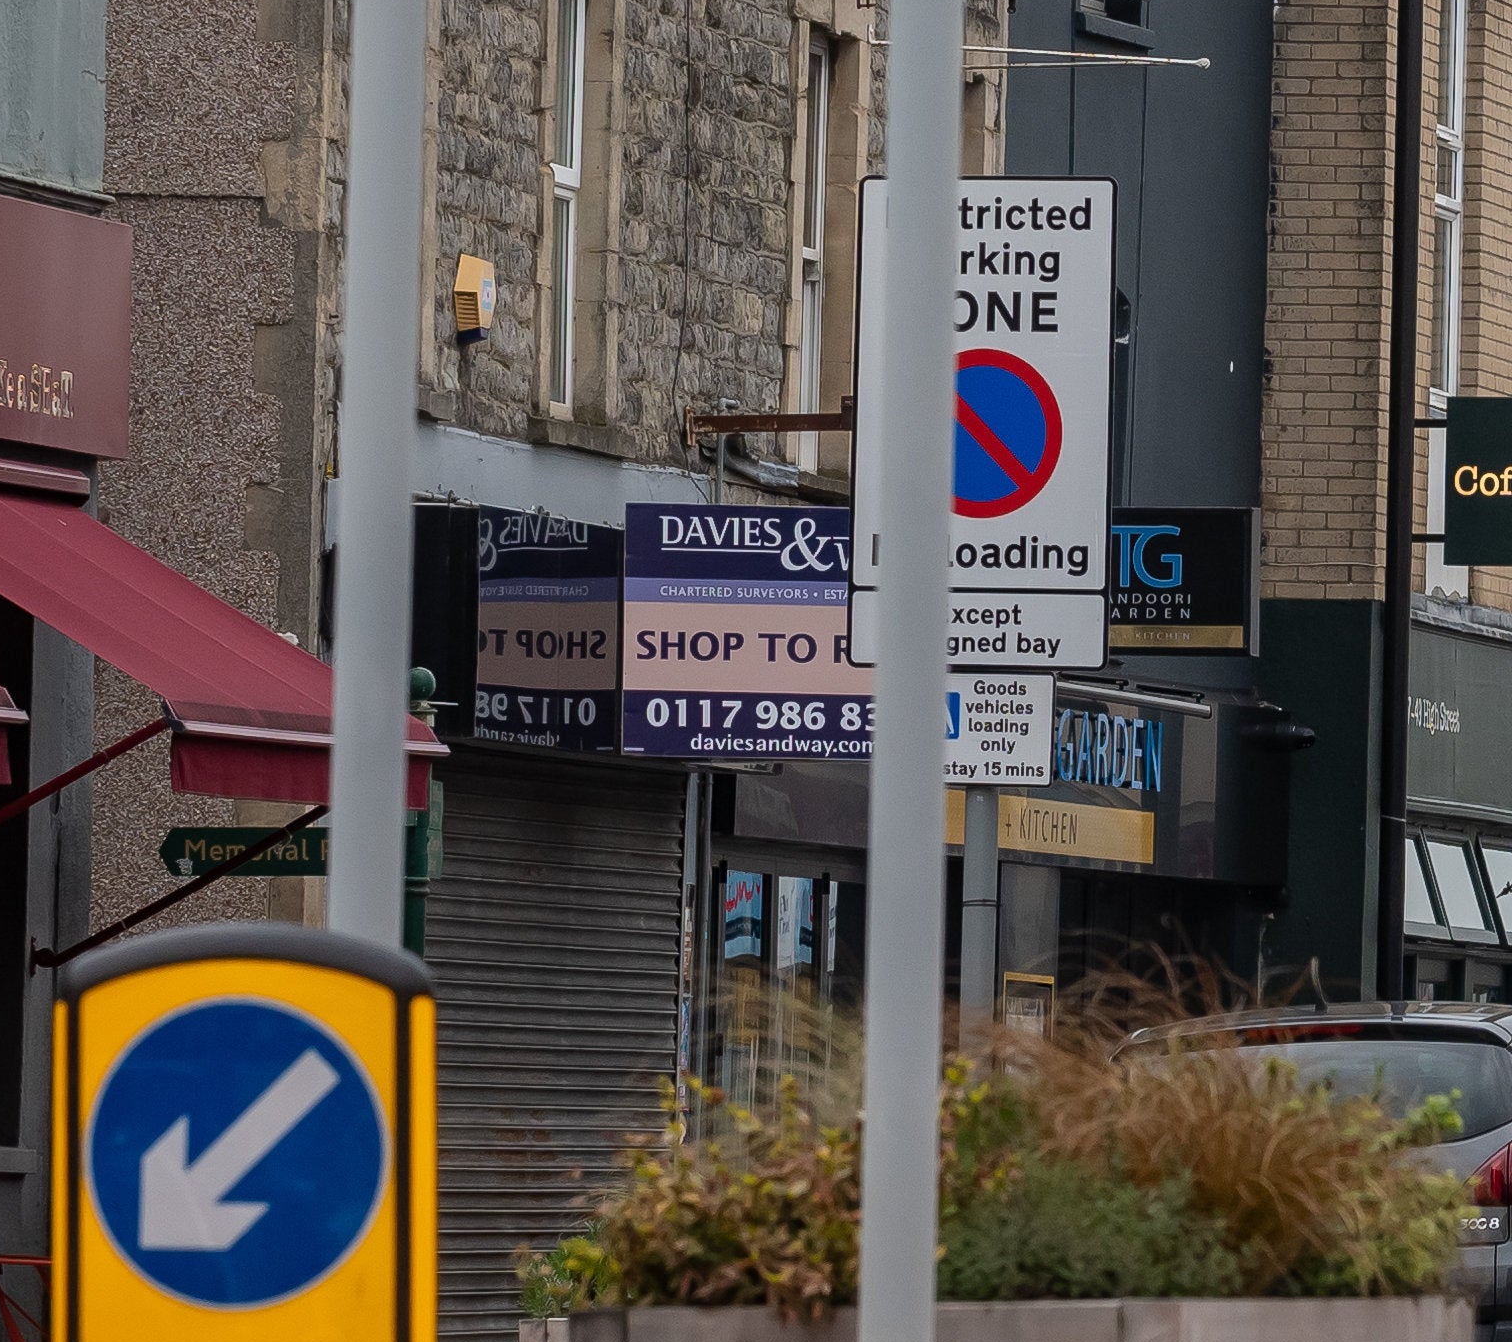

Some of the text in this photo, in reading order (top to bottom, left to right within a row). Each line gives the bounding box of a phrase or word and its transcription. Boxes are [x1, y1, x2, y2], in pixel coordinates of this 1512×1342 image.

[956, 196, 1092, 231] tricted
[958, 241, 1061, 283] rking
[953, 290, 1059, 333] ONE
[659, 515, 782, 548] DAVIES
[781, 517, 834, 572] &
[947, 536, 1089, 577] oading
[659, 585, 849, 601] CHARTERED SURVEYORS ESTA
[1110, 593, 1191, 605] NDOORI
[949, 604, 1022, 628] xcept
[1111, 608, 1191, 619] ARDEN
[636, 630, 745, 662] SHOP
[758, 633, 817, 664] TO
[947, 632, 1061, 659] gned bay
[973, 679, 1027, 696] Goods
[646, 698, 742, 729] 0117
[755, 700, 826, 731] 986
[965, 700, 1034, 715] vehicles
[968, 718, 1030, 736] loading
[980, 737, 1016, 754] only
[1057, 709, 1163, 792] GARDEN
[984, 762, 1002, 776] 15
[1005, 762, 1044, 778] mins
[1020, 809, 1078, 844] KITCHEN
